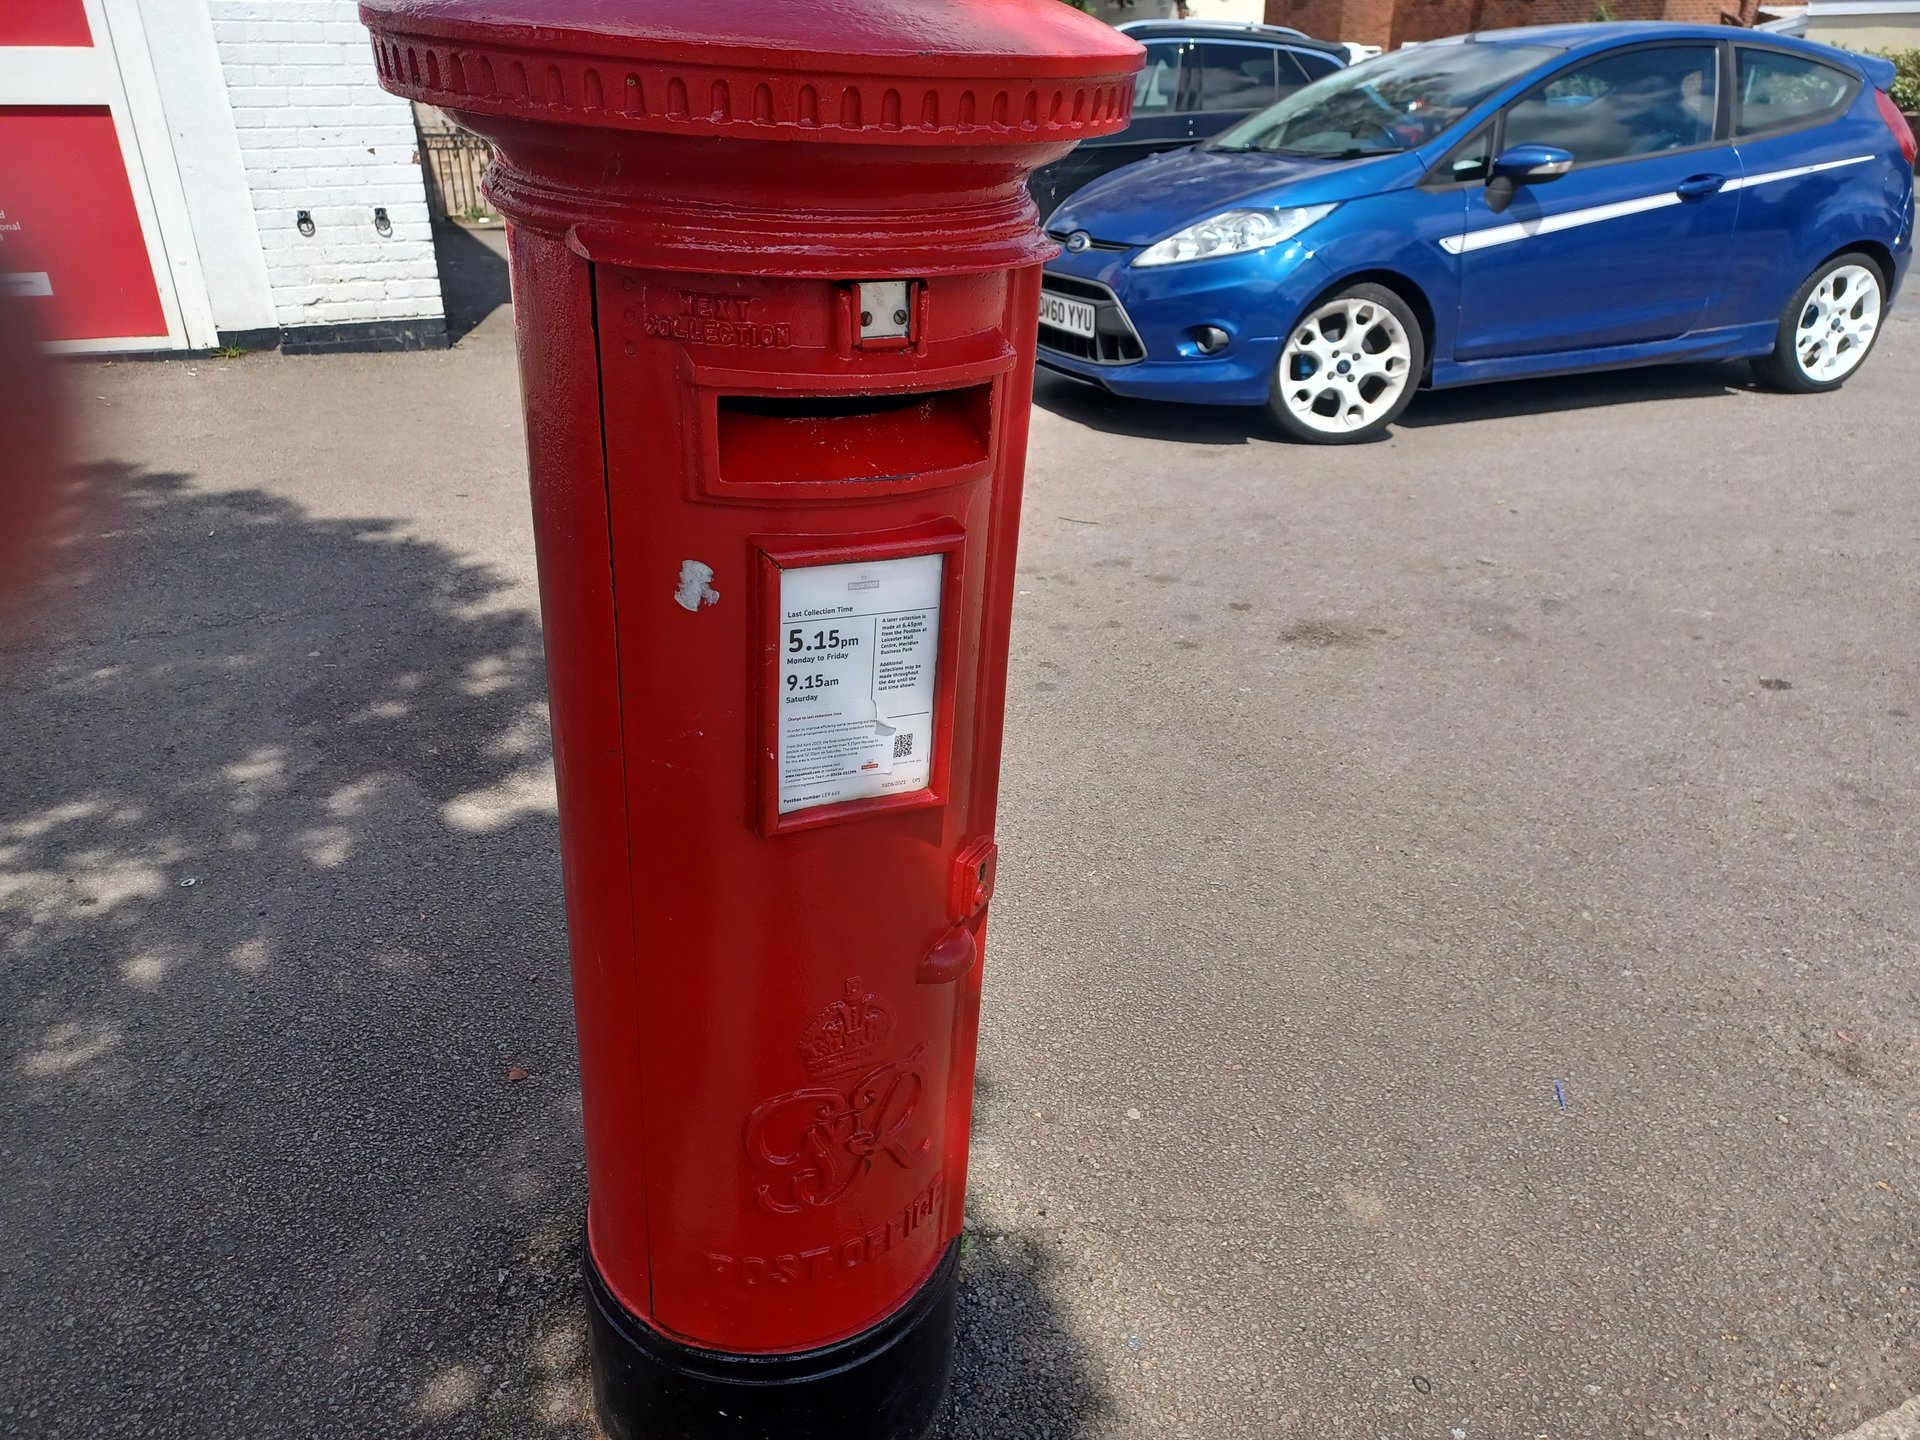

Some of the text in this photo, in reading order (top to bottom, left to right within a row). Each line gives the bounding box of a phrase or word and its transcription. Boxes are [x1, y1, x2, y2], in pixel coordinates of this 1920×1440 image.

[1068, 304, 1092, 331] YYU
[644, 313, 791, 346] COLLECTION
[804, 608, 835, 616] Collection
[787, 656, 815, 664] Monday
[786, 694, 818, 703] Saturday
[705, 1247, 831, 1285] POST
